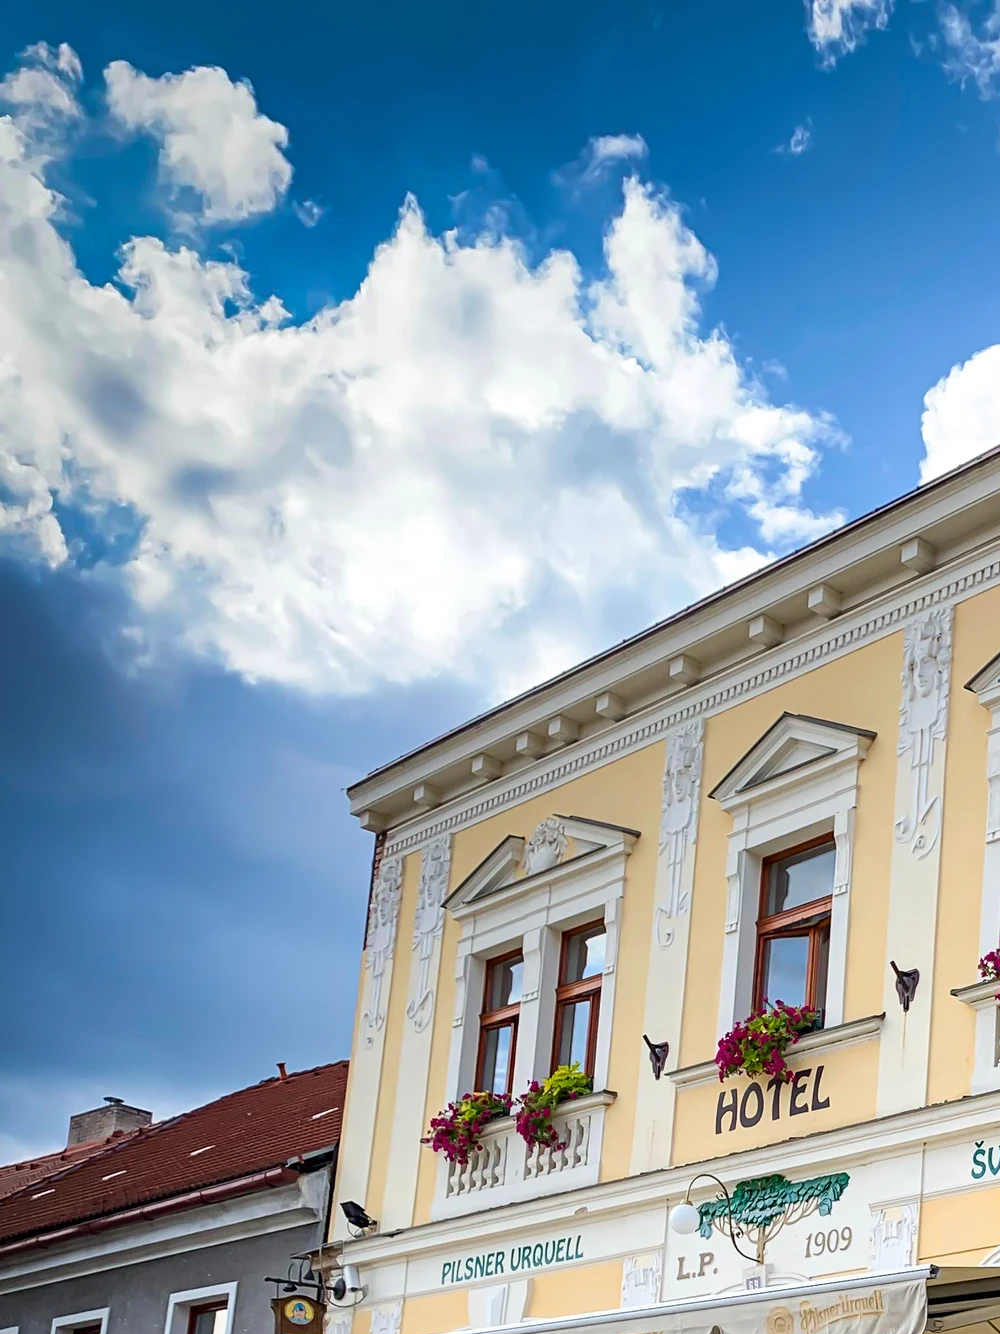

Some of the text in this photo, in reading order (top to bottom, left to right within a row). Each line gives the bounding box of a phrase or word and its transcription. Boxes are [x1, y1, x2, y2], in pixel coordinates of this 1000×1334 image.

[715, 1065, 830, 1134] HOTEL
[441, 1235, 584, 1285] PILSNER URQUELL
[804, 1226, 852, 1258] 1909
[676, 1252, 718, 1280] L.P.
